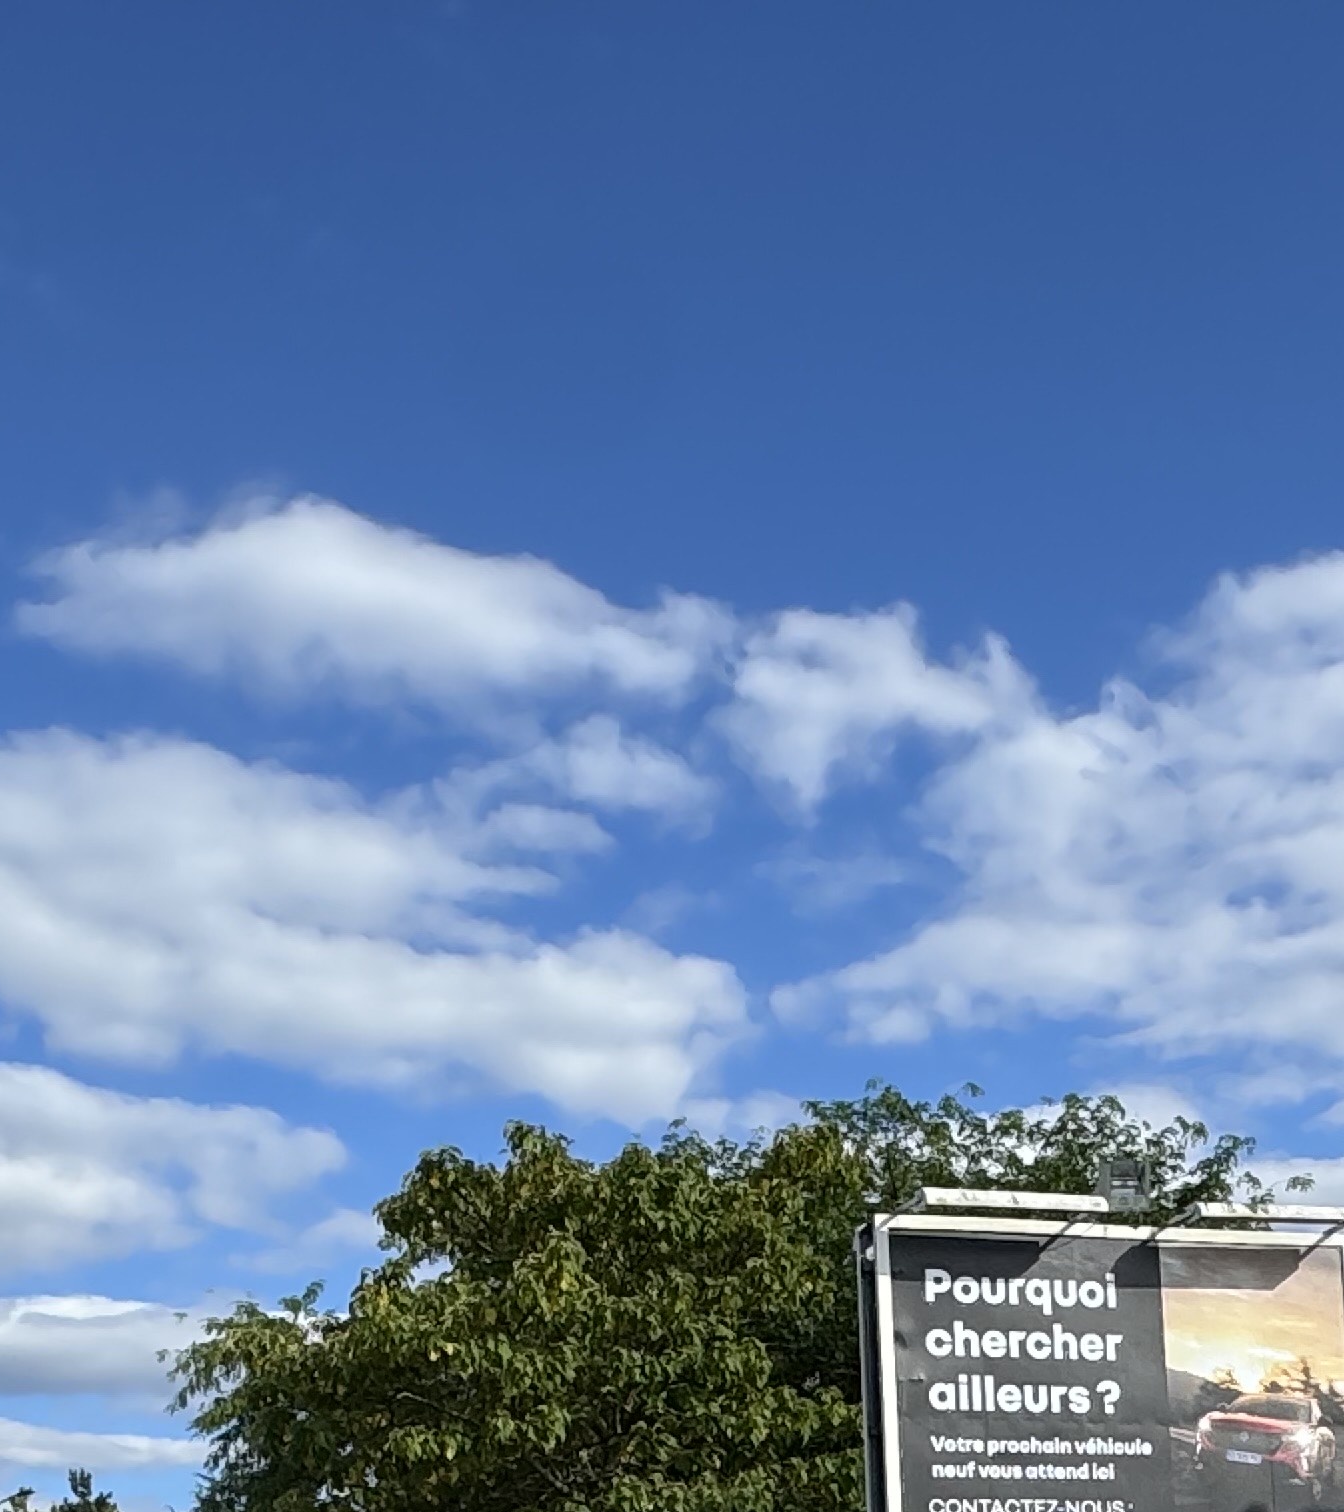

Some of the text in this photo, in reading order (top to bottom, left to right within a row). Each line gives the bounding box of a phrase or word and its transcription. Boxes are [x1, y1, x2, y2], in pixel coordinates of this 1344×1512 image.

[924, 1268, 1118, 1316] Pourquoi
[925, 1320, 1124, 1362] chercher
[928, 1374, 1092, 1414] ailleurs
[930, 1435, 1153, 1457] Votre prochain véhicule
[931, 1461, 1116, 1481] neuf vous attend ici
